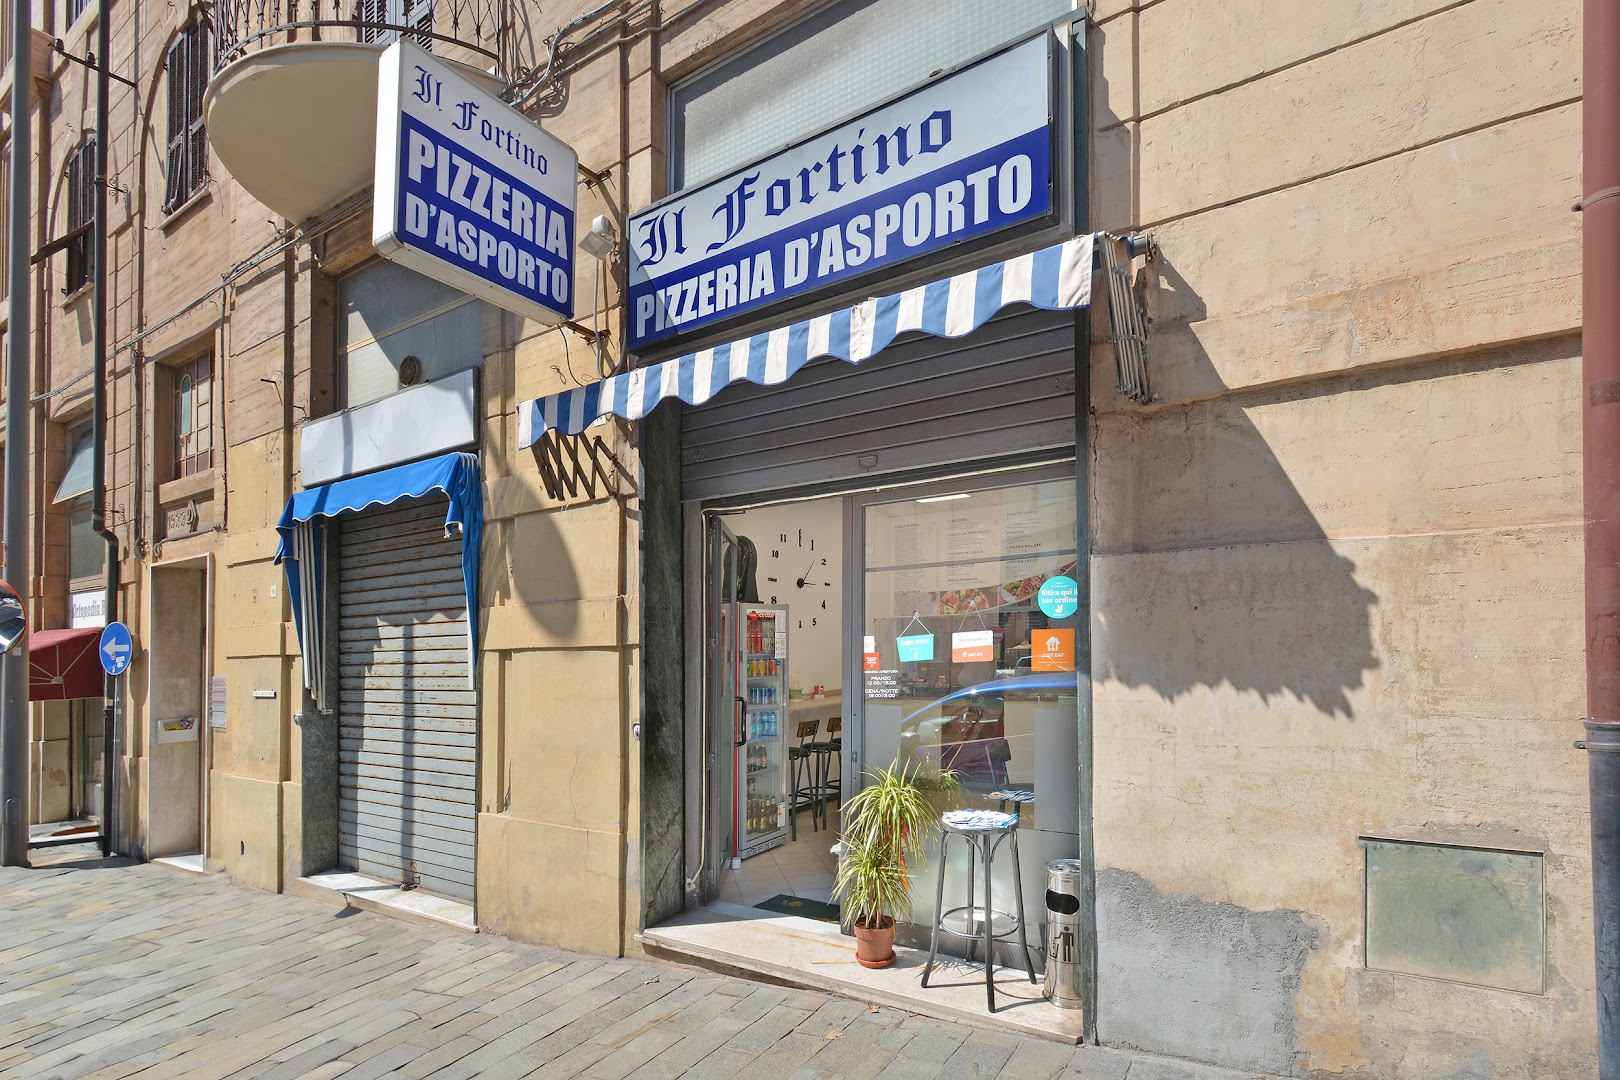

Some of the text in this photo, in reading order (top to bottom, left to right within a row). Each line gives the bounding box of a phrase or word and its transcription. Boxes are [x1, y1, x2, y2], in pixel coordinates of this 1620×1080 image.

[412, 65, 548, 176] Il Fortino
[408, 128, 568, 260] PIZZERIA
[637, 110, 952, 272] Il Fortino
[405, 191, 569, 304] D'ASPORTO
[636, 154, 1032, 339] PIZZERIA D'ASPORTO
[780, 534, 787, 542] 11
[811, 539, 814, 551] 1
[771, 550, 779, 558] 10
[820, 558, 827, 566] 2
[1061, 588, 1072, 597] qui
[770, 596, 778, 604] 8
[821, 600, 826, 610] 4
[812, 617, 817, 626] 5
